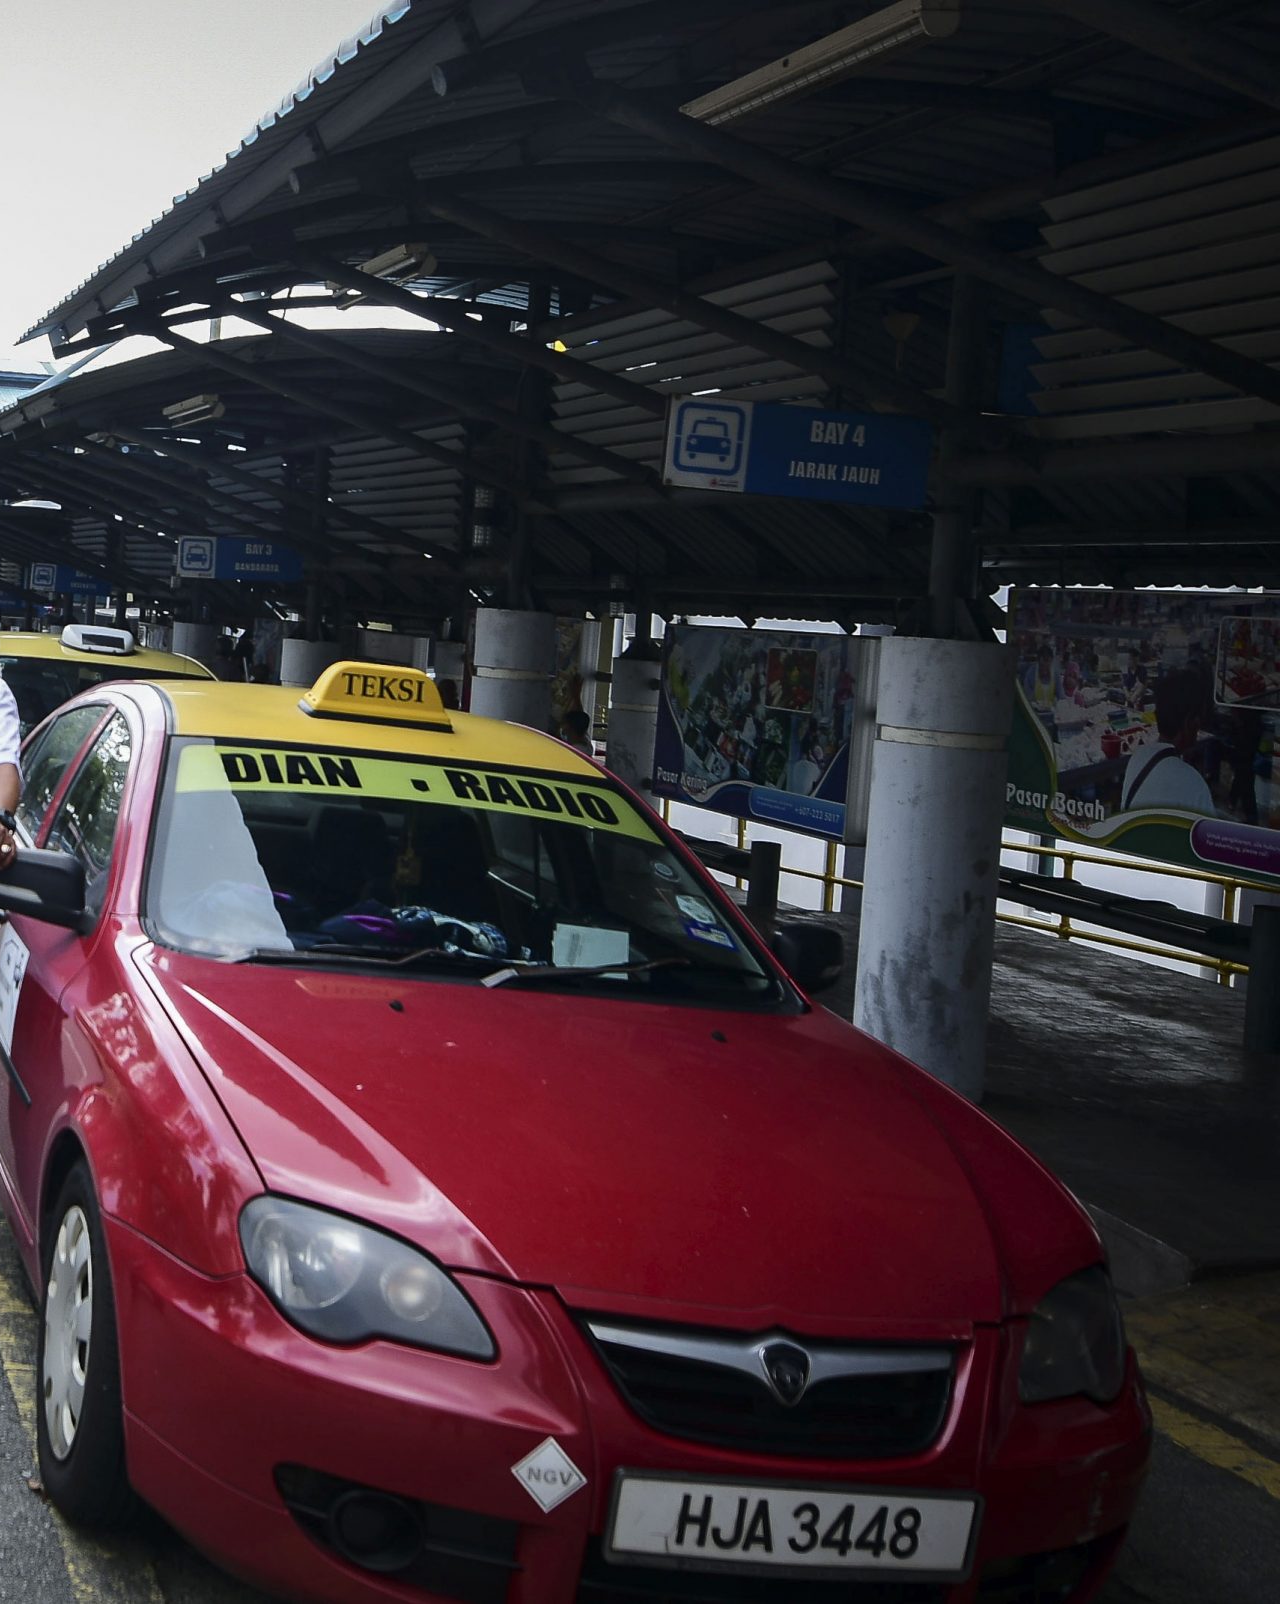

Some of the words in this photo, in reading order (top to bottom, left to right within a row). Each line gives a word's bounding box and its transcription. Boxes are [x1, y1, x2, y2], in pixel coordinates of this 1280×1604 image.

[810, 420, 849, 446] BAY
[851, 424, 866, 448] 4
[788, 460, 837, 481] JARAK
[841, 465, 881, 486] JAUH
[245, 543, 264, 555] BAY
[265, 544, 273, 556] 3
[341, 672, 425, 703] TEKSI
[220, 752, 363, 790] DIAN
[443, 768, 621, 826] RADIO
[657, 766, 679, 784] Pasar
[1006, 782, 1048, 810] Pasar
[1050, 791, 1105, 822] Basah
[528, 1466, 574, 1487] NGV
[674, 1493, 773, 1554] HJA
[787, 1502, 921, 1560] 3448
